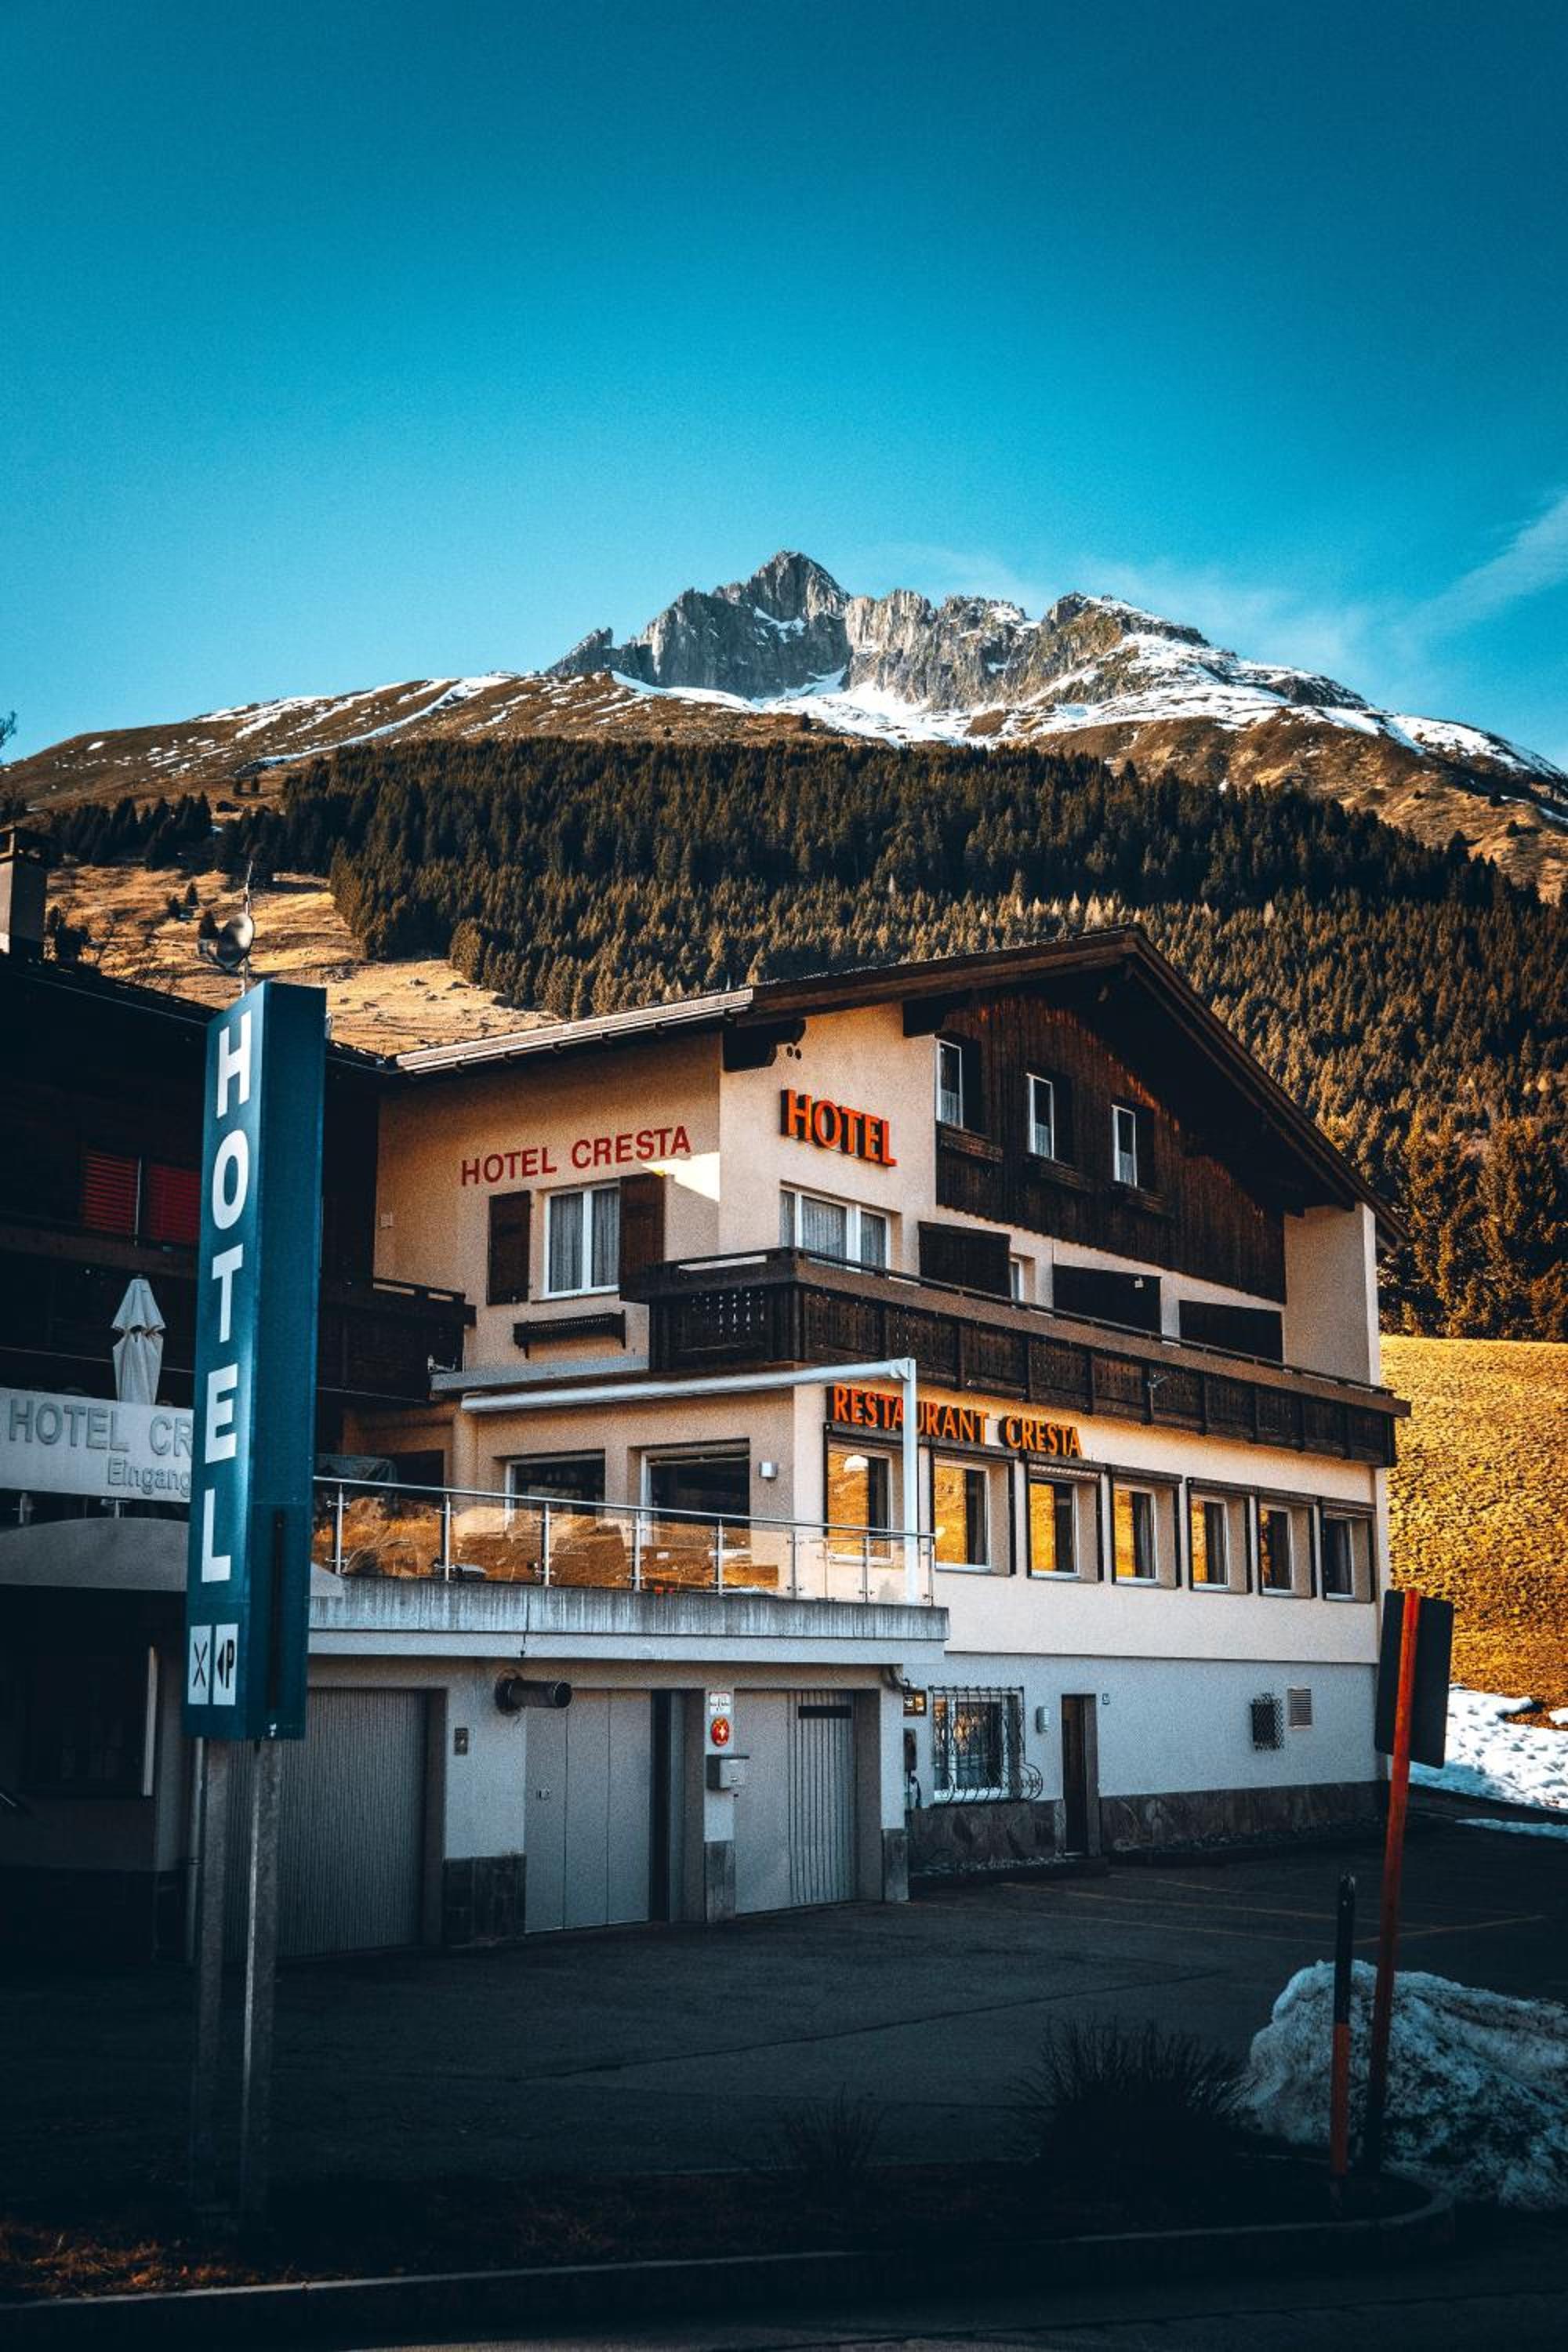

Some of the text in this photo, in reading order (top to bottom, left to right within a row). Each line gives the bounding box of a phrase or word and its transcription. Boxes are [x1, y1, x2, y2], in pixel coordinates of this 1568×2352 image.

[461, 1126, 691, 1186] HOTEL CRESTA
[780, 1088, 898, 1167] HOTEL
[201, 1010, 252, 1584] HOTEL
[9, 1399, 131, 1452] HOTEL
[997, 1414, 1082, 1457] CRESTA
